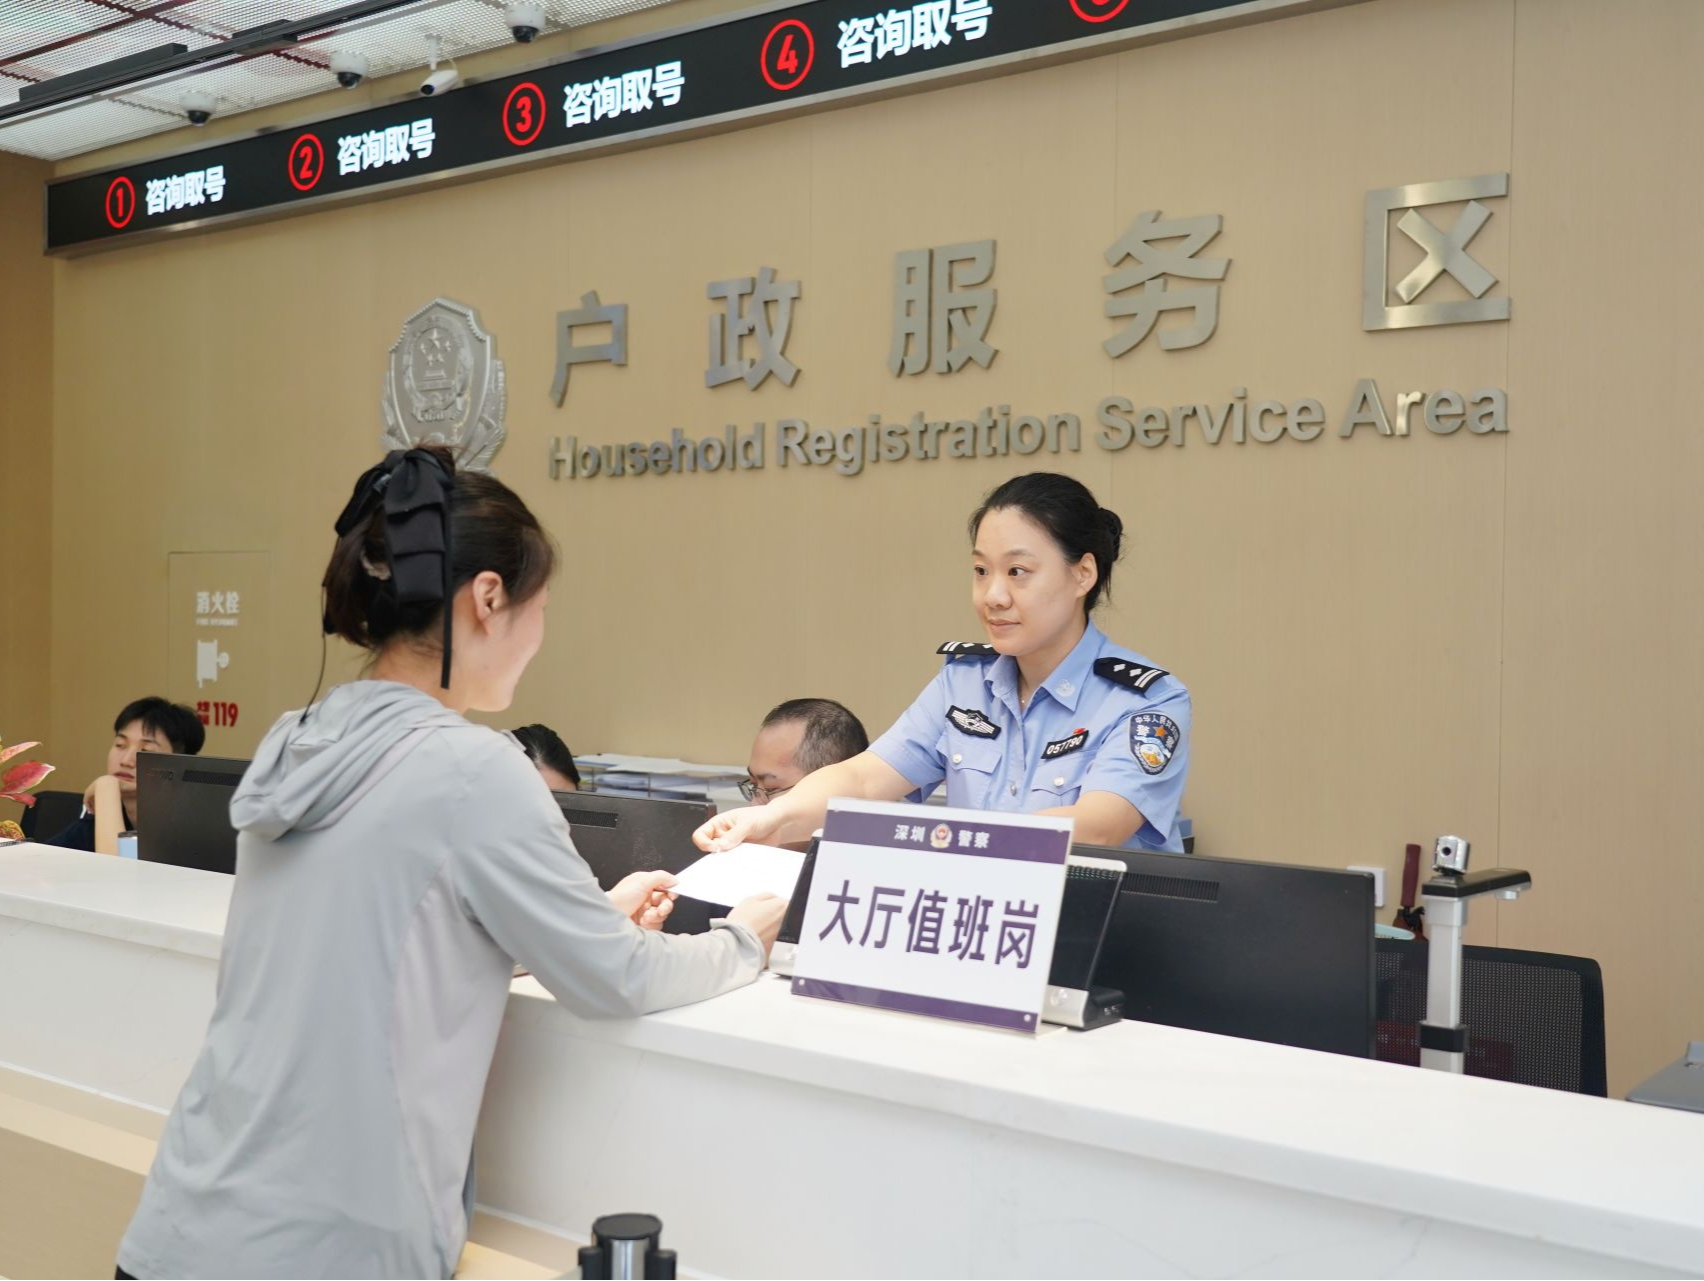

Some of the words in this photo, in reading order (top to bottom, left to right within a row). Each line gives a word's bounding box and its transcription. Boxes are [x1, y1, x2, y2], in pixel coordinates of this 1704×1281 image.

[837, 0, 993, 68] 咨询取号
[563, 61, 684, 128] 咨询取号
[337, 118, 435, 176] 咨询取号
[146, 166, 226, 216] 咨询取号
[550, 172, 1511, 408] 户政服务区
[549, 423, 765, 480] Household
[776, 405, 1081, 476] Registration
[1097, 387, 1326, 452] Service
[1338, 378, 1510, 439] Area
[213, 702, 239, 727] 119
[1046, 735, 1084, 755] 057790
[894, 824, 926, 842] 深圳
[958, 829, 990, 848] 警察
[819, 880, 1039, 969] 大厅值班岗
